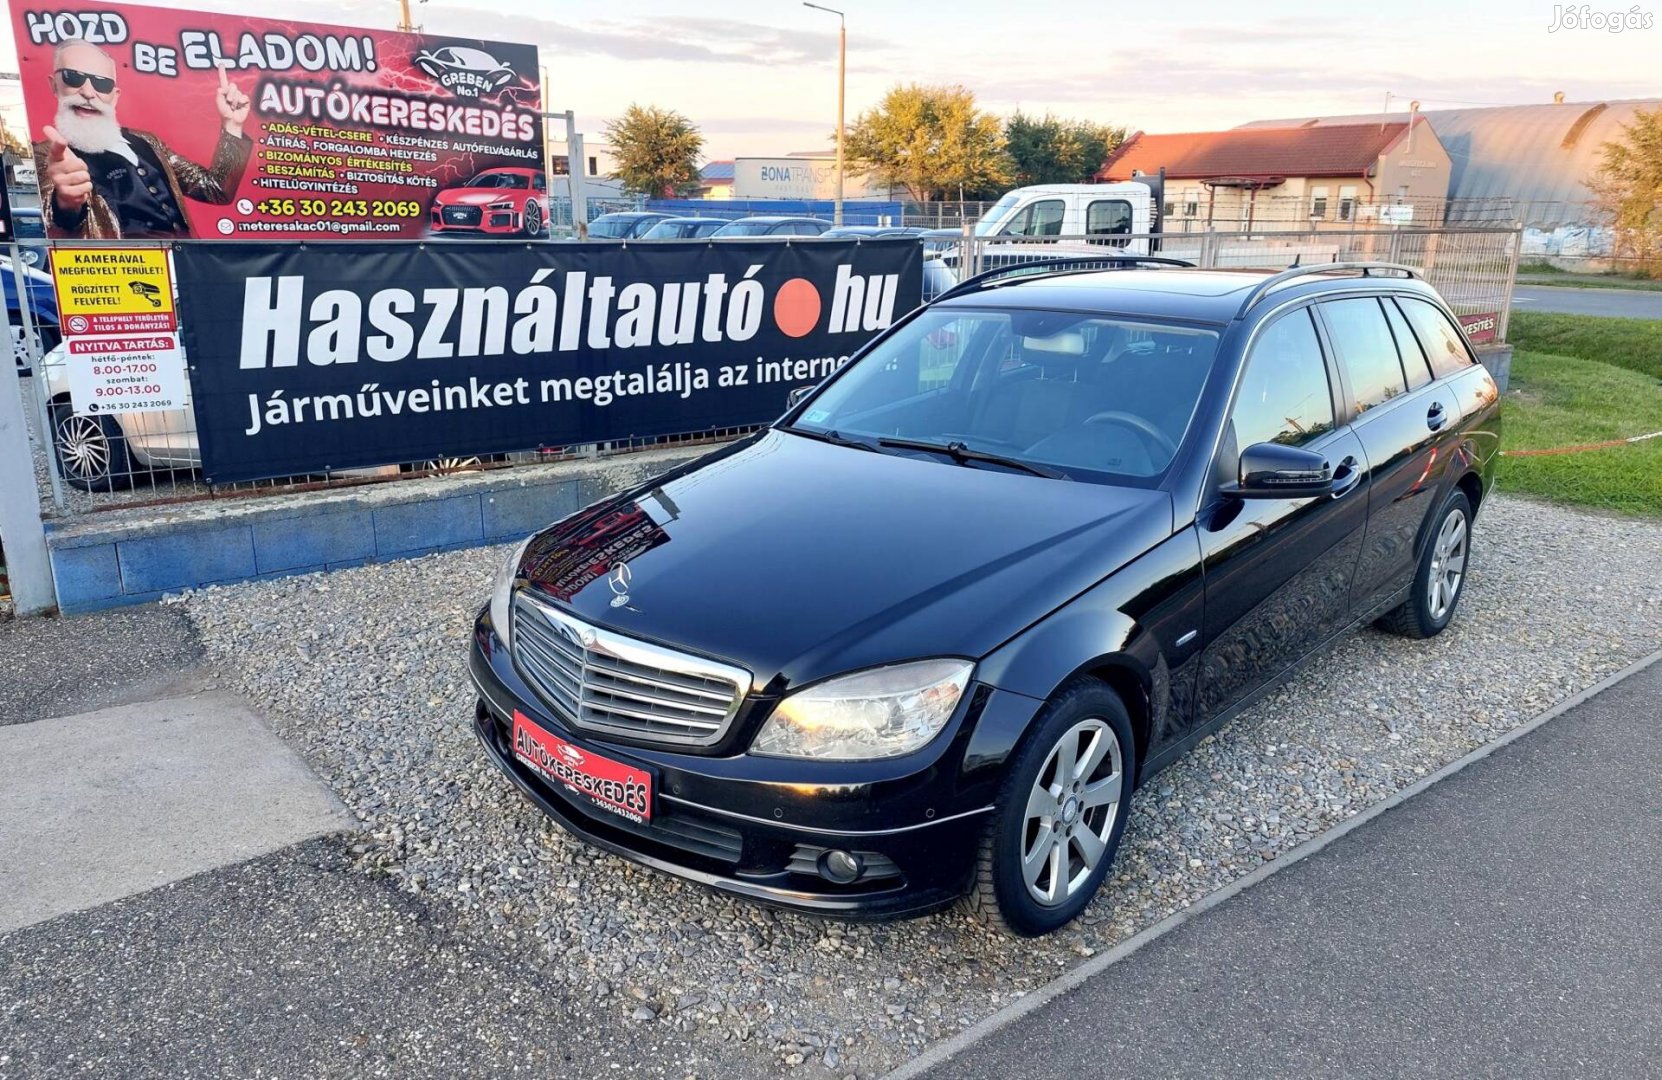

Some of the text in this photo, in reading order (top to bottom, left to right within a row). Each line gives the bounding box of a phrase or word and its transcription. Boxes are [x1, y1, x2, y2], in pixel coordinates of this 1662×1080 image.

[27, 12, 376, 76] HOZD BE ELADOM!
[441, 72, 493, 93] GREBEN
[456, 85, 479, 97] No.1
[259, 82, 535, 141] AUTÓKERESKEDÉS
[266, 135, 437, 162] ÁTÍRÁS, FORGALOMBA HELYEZÉS
[268, 122, 539, 159] ADÁS-VÉTEL-CSERE KÉSZPÉNZES AUTÓFELVÁSÁRLÁS
[266, 150, 413, 172] BIZOMÁNYOS ÉRTÉKESÍTÉS
[267, 164, 438, 188] BESZÁMÍTÁS BIZTOSÍTÁS KÖTÉS
[260, 178, 358, 194] HITELÜGYINTÉZÉS
[257, 199, 420, 217] +36 30 243 2069
[74, 252, 146, 264] KAMERÁVAL
[59, 265, 163, 275] MEGFIGYELT TERÜLET!
[71, 284, 120, 294] RÖGZÍTETT
[74, 294, 121, 305] FELVÉTEL!
[239, 264, 765, 370] Használtautó
[75, 338, 169, 352] NYITVA TARTÁS:
[91, 354, 155, 363] hétfő-péntek:
[93, 363, 157, 375] 8.00-17.00
[106, 376, 149, 384] szombat:
[95, 384, 161, 397] 9.00-13.00
[245, 376, 530, 435] Járműveinket
[540, 361, 710, 407] megtalálja
[717, 364, 749, 386] az
[516, 724, 648, 815] AUTÓKERESKEDÉS
